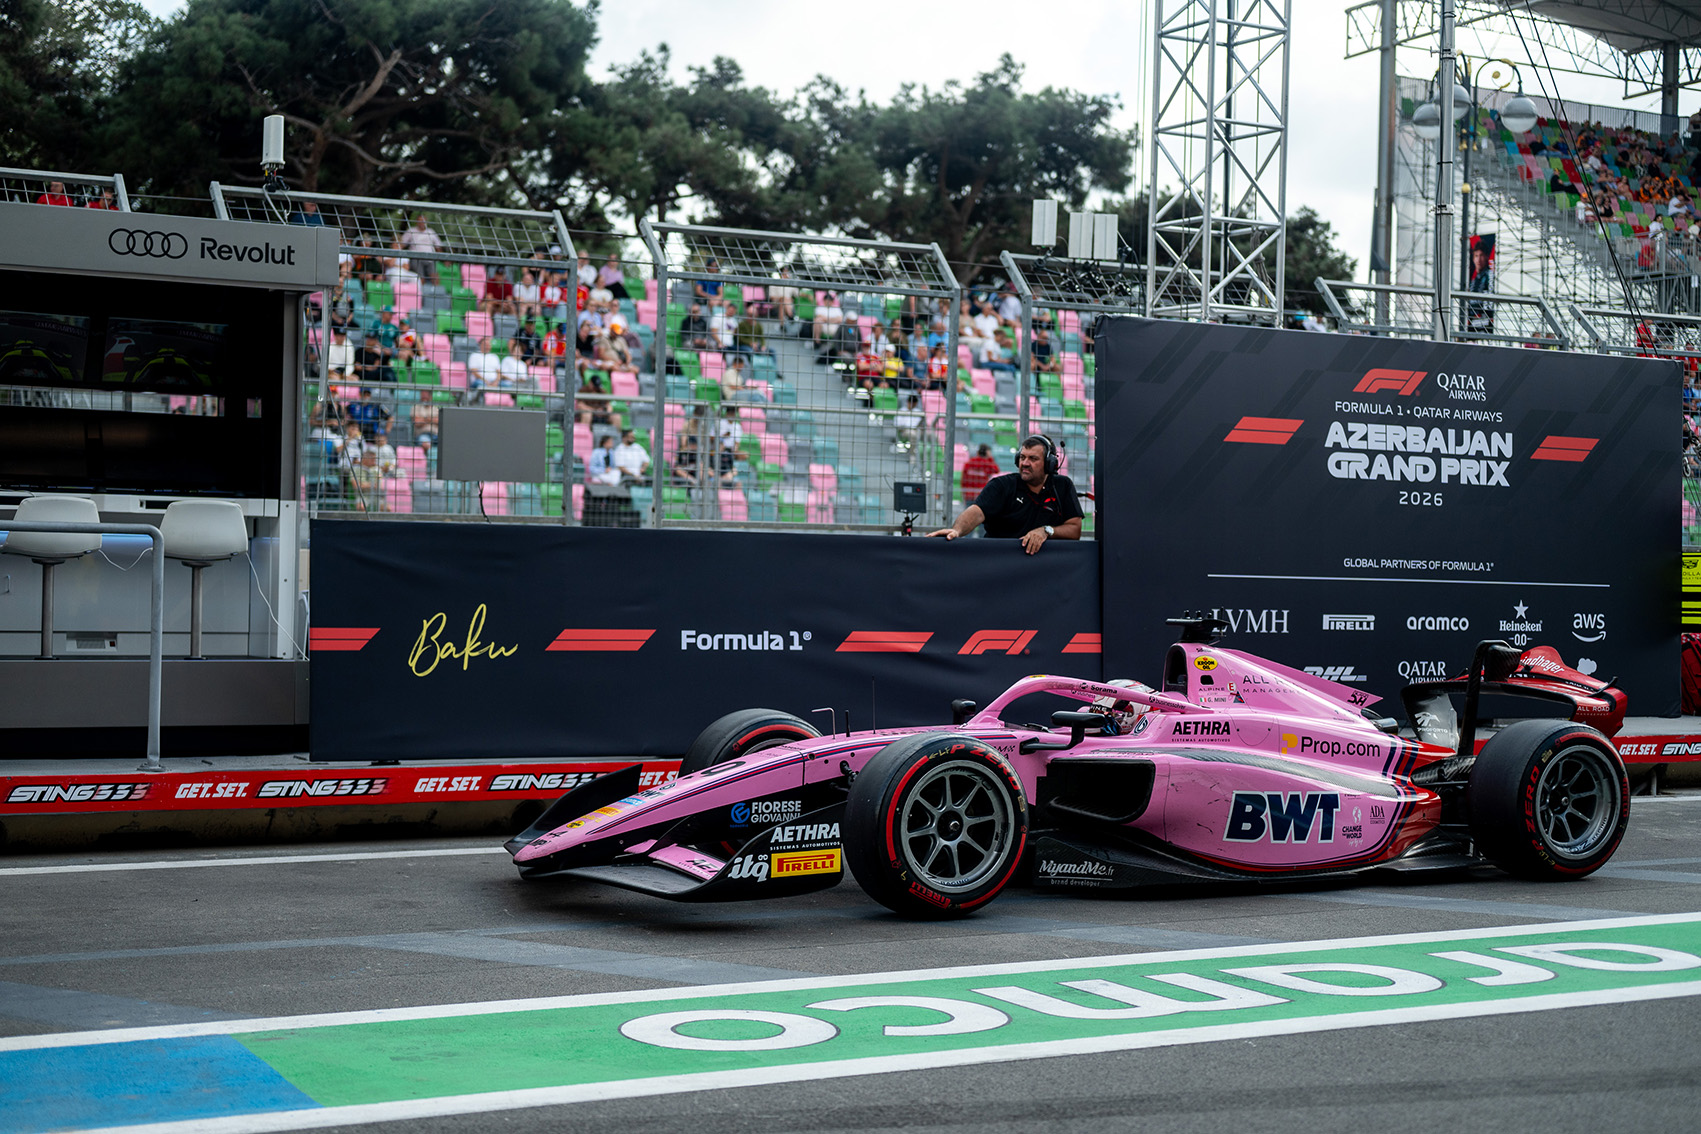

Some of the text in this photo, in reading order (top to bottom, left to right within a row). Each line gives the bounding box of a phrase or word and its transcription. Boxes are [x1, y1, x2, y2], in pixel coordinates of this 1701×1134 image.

[200, 237, 295, 266] Revolut
[1437, 372, 1485, 392] QATAR
[1449, 390, 1486, 401] AIRWAYS
[1335, 401, 1503, 423] FORMULA 1 QATAR AIRWAYS
[1324, 421, 1513, 459] AZERBAIJAN
[1327, 451, 1510, 487] GRAND PRIX
[1399, 491, 1443, 507] 2026
[1343, 558, 1379, 568] GLOBAL
[1380, 559, 1427, 570] PARTNERS
[1428, 561, 1441, 570] OF
[1442, 561, 1485, 571] FORMULA
[1212, 608, 1289, 633] LVMH
[1322, 614, 1375, 630] PIRELLI
[1407, 616, 1469, 631] aramco
[1499, 620, 1543, 632] Heineken
[1573, 613, 1605, 629] aws
[408, 603, 518, 677] Baku
[680, 630, 784, 651] Formula
[1398, 661, 1446, 679] QATAR
[1520, 655, 1564, 674] indhager
[1243, 675, 1269, 684] ALL
[1303, 666, 1367, 682] DHL
[1091, 684, 1118, 694] Sorama
[1229, 682, 1234, 691] E
[1172, 721, 1231, 735] AETHRA
[1301, 736, 1381, 758] Prop.com
[950, 744, 1021, 790] P ZERO
[751, 800, 802, 814] FIORESE
[1525, 765, 1540, 833] ZERO
[750, 812, 801, 823] GIOVANNI
[1222, 790, 1341, 844] BWT
[1370, 805, 1385, 817] ADA
[770, 823, 840, 843] AETHRA
[801, 841, 841, 849] AUTOMOTIVOS
[777, 854, 835, 873] PIRELLI
[1039, 860, 1115, 877] MyandMe.fr
[909, 881, 950, 910] PIRELLI
